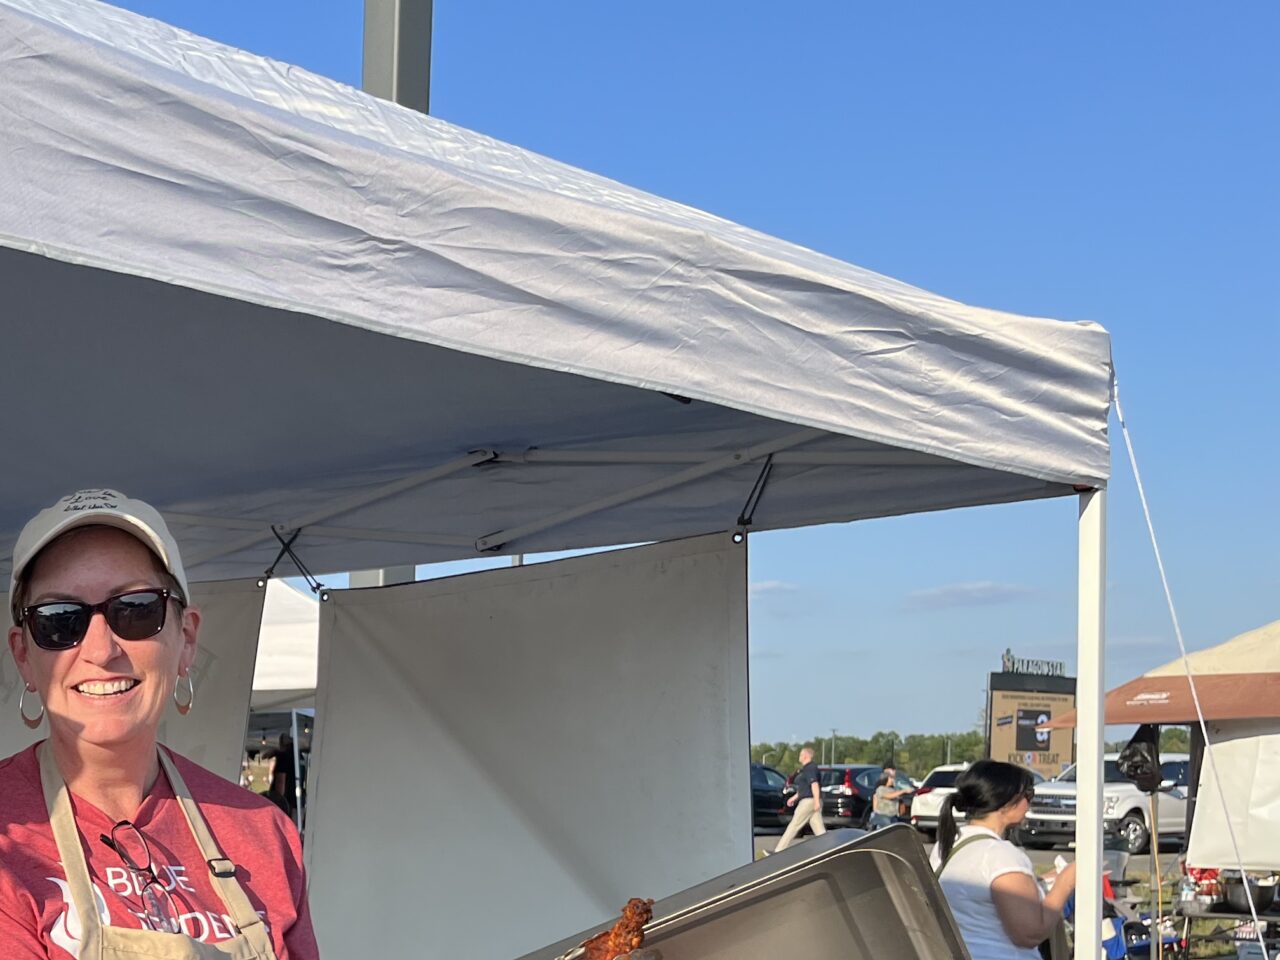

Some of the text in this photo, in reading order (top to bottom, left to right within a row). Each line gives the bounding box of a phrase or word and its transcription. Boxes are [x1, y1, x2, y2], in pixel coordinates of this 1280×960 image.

[1014, 658, 1048, 675] PARAGON
[1039, 753, 1060, 765] TREAT
[106, 865, 196, 897] BLUE
